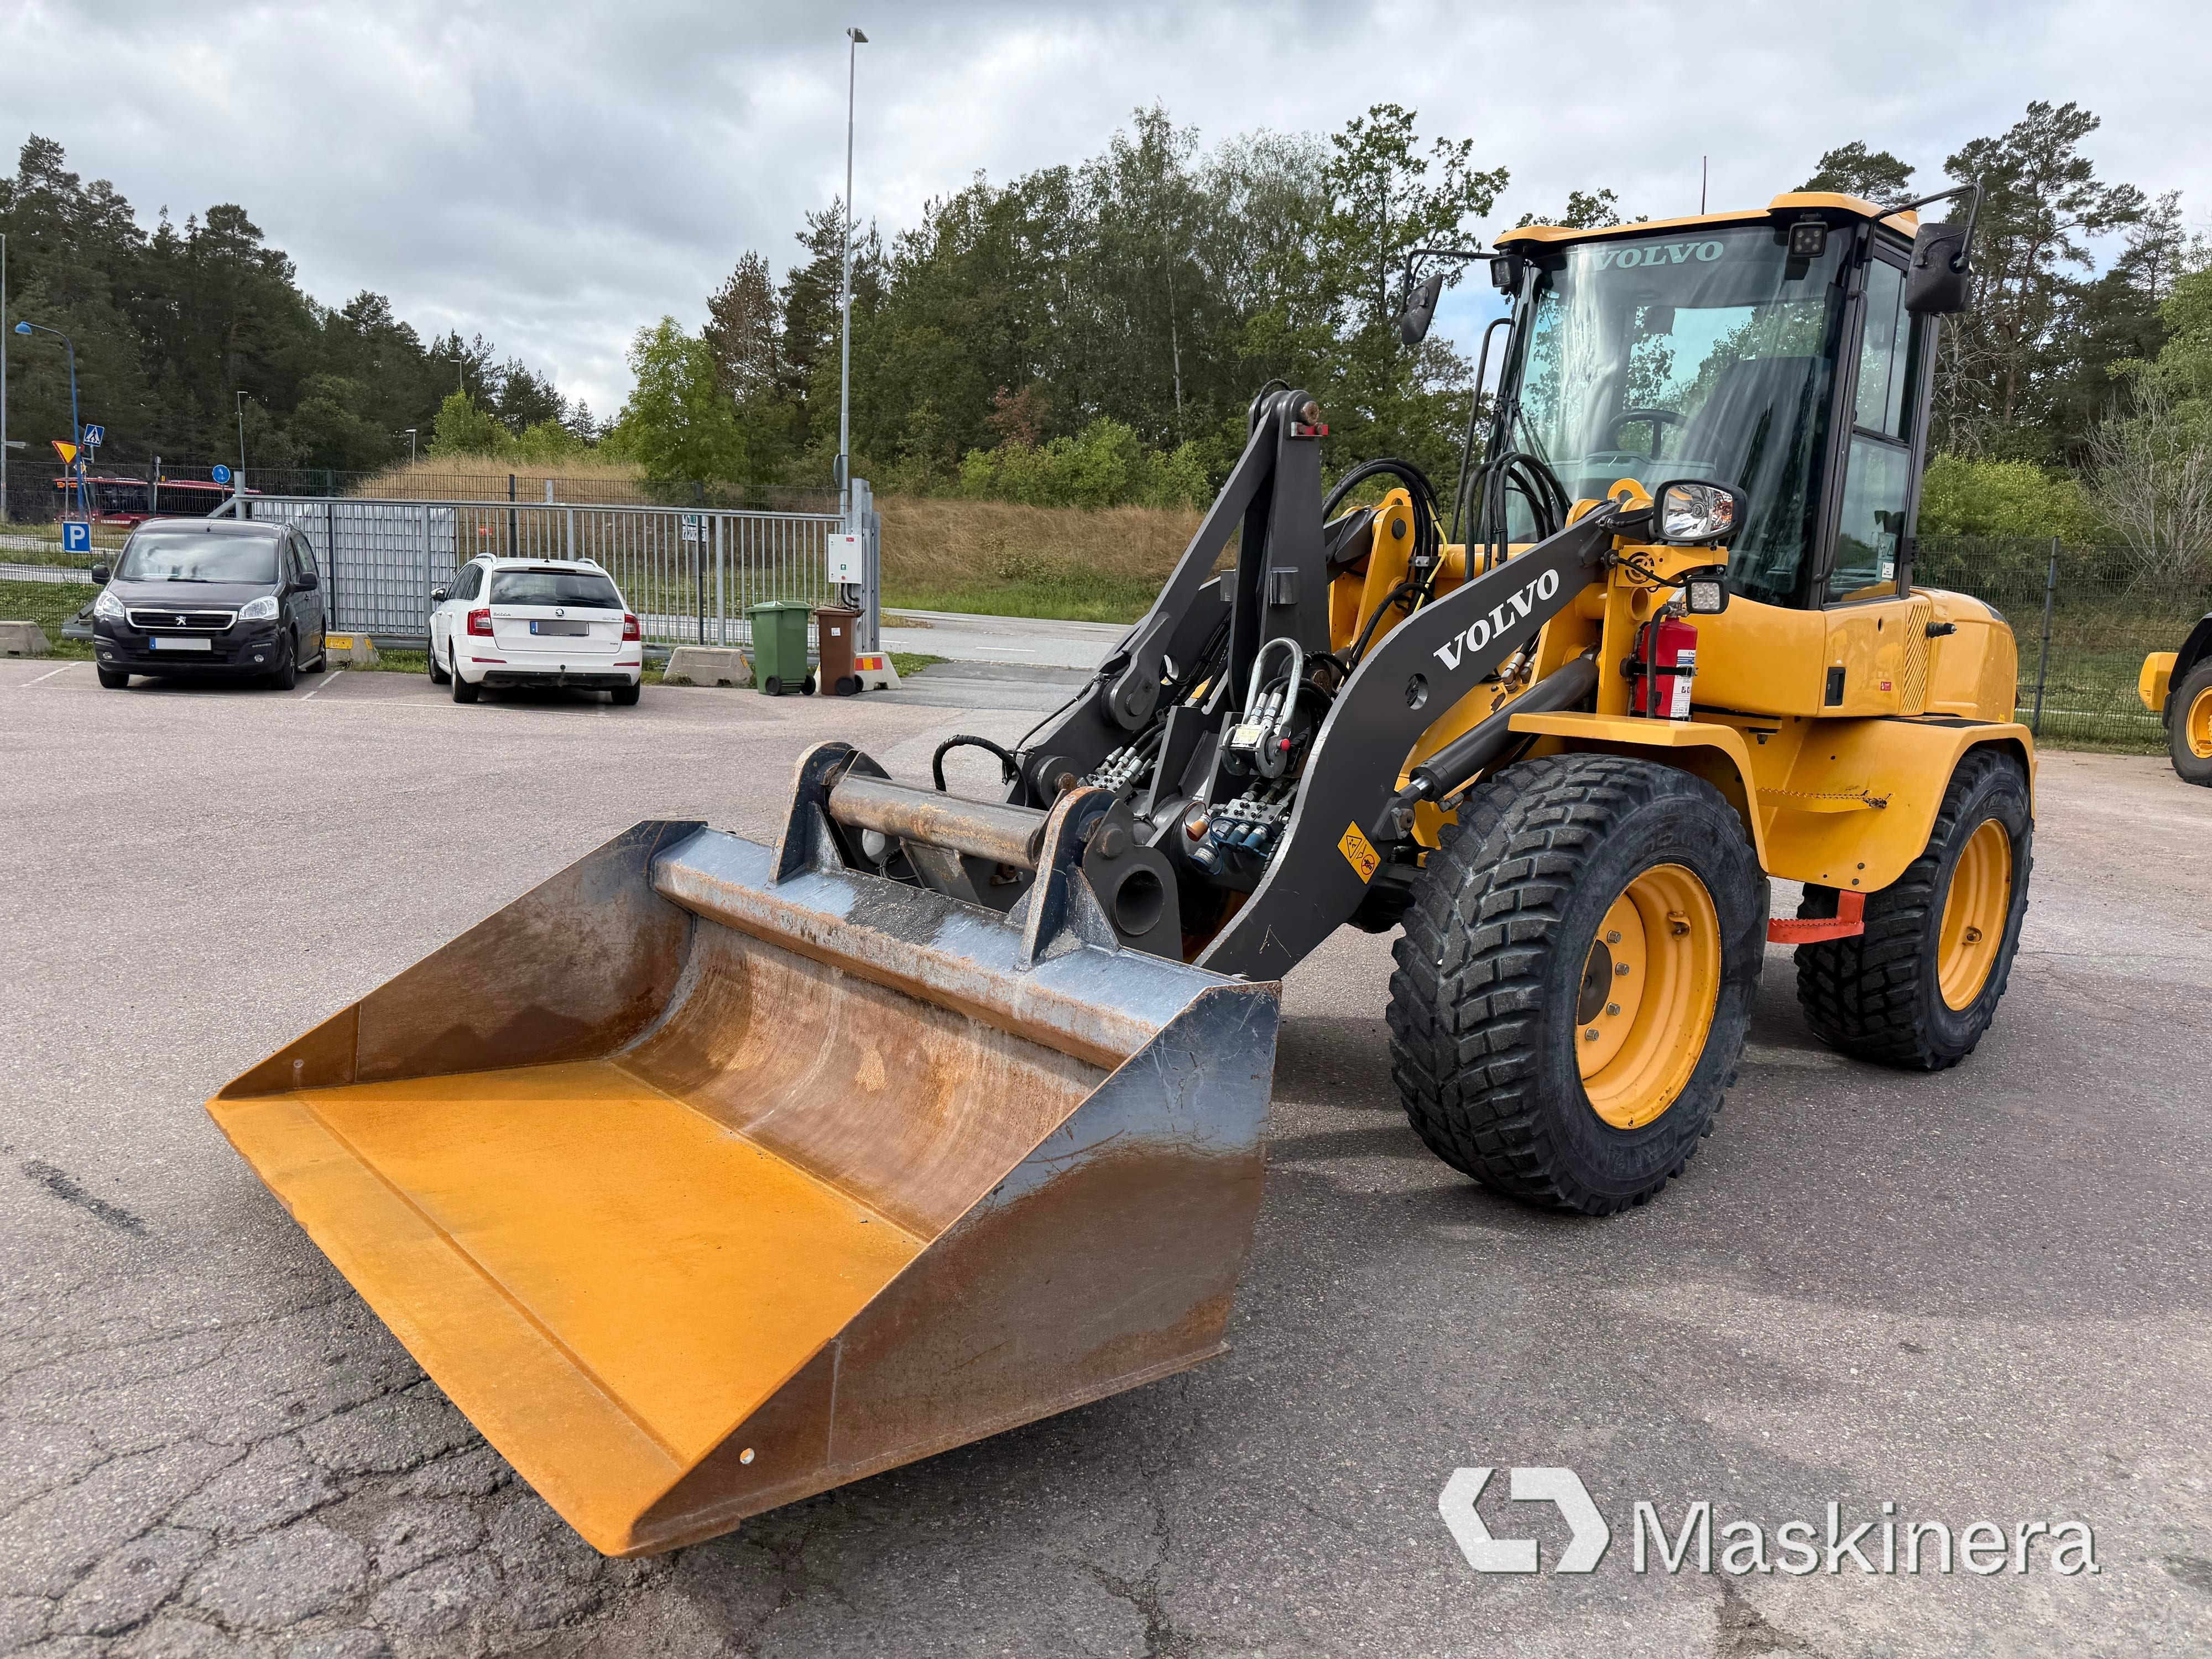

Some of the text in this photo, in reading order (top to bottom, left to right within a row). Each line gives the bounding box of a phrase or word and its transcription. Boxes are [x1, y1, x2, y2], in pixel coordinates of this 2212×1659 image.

[1591, 241, 1724, 271] VOLVO
[70, 525, 85, 549] P
[1433, 568, 1559, 671] VOLVO
